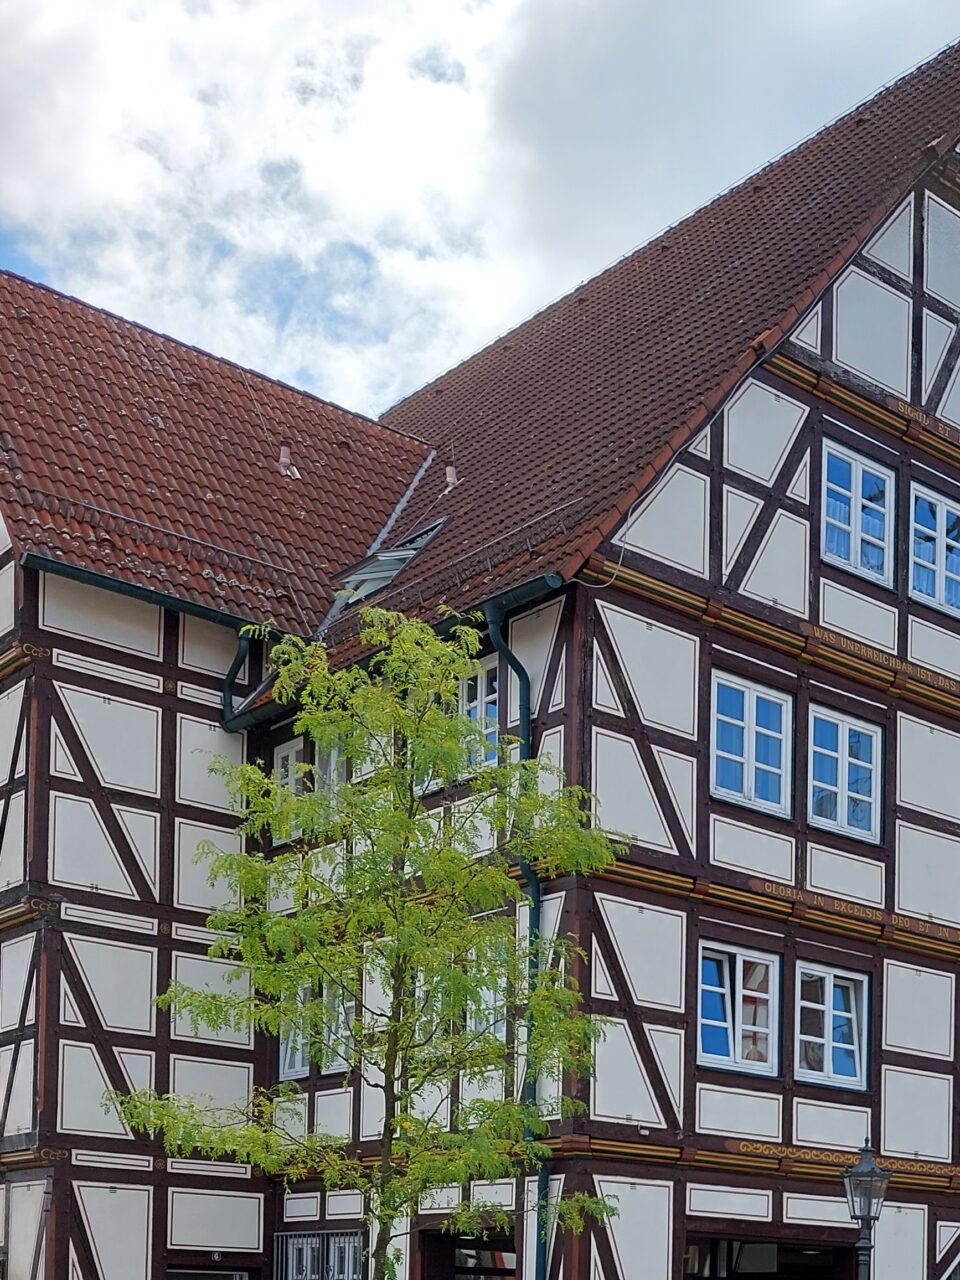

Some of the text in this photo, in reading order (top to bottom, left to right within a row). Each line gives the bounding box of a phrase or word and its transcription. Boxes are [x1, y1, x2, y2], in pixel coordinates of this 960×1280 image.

[898, 401, 929, 426] SIGRID
[938, 423, 951, 437] ET
[813, 626, 836, 644] WAS
[841, 639, 912, 674] UNERREICHBAR
[938, 676, 956, 691] DAS
[764, 882, 804, 901] GLORIA
[813, 894, 825, 906] IN
[834, 900, 883, 921] EXCELSIS
[892, 914, 910, 928] DEO
[919, 921, 931, 933] ET
[939, 927, 950, 937] IN
